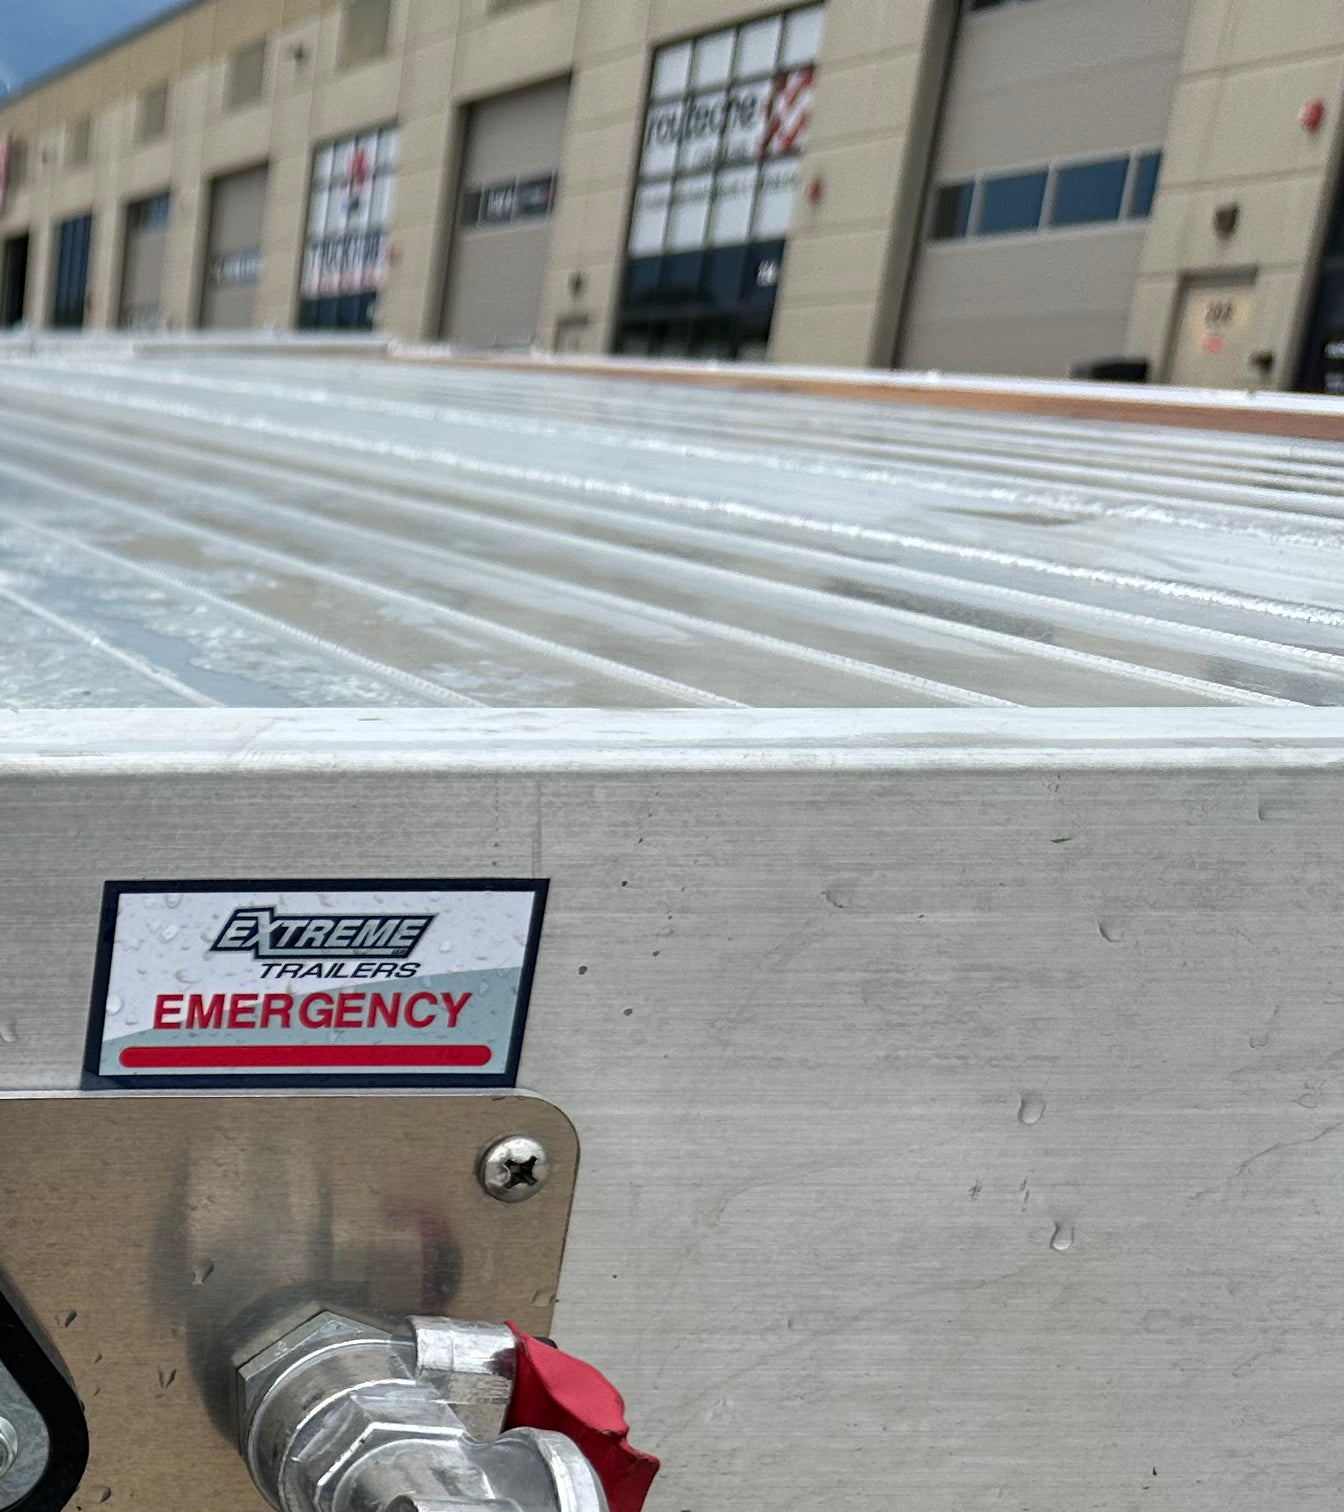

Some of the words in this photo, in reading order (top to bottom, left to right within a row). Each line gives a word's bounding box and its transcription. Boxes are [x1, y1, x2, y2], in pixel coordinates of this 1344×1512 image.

[210, 906, 437, 958] EXTREME
[260, 962, 422, 979] TRAILERS
[152, 991, 473, 1030] EMERGENCY
